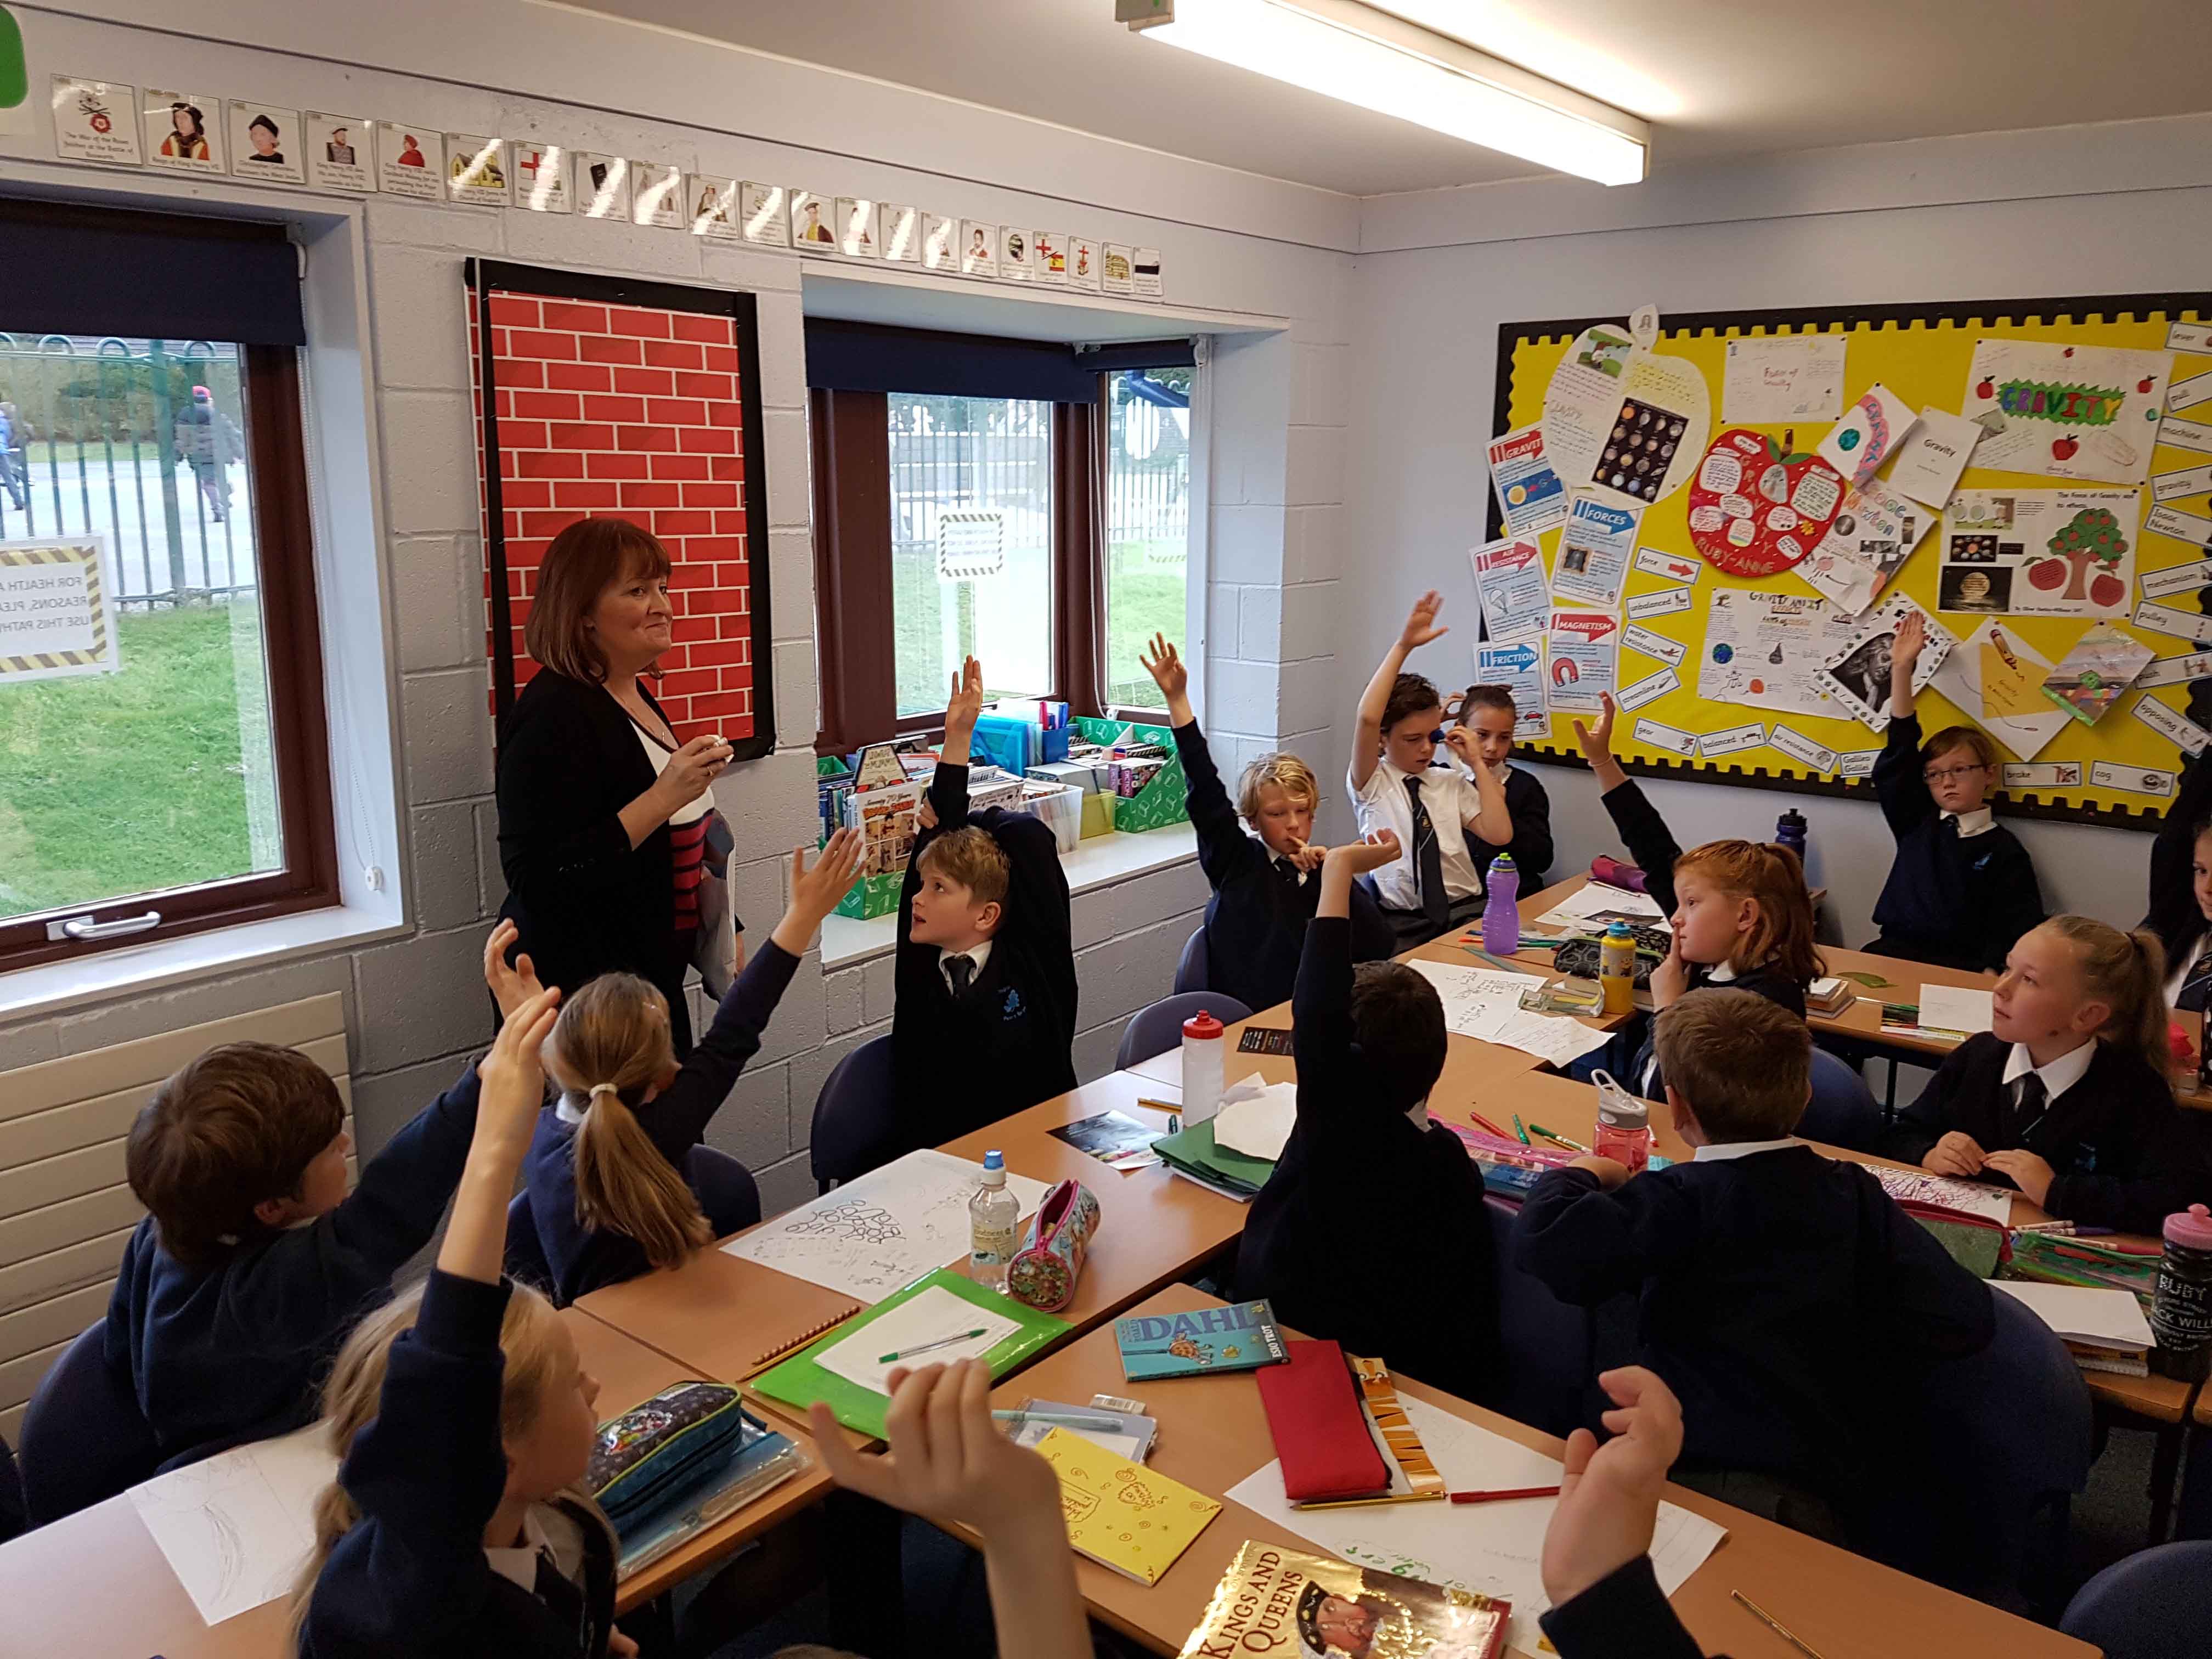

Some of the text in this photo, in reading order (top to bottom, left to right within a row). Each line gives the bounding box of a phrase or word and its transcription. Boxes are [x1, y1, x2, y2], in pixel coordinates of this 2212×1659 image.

[2001, 387, 2125, 420] GRAVITY
[1505, 438, 1542, 458] GRAVIT
[1923, 439, 1957, 457] Gravity
[1587, 510, 1628, 525] FORCES
[1559, 621, 1612, 630] MAGNETISM
[2137, 612, 2168, 626] pulley
[1493, 653, 1537, 665] FRICTION
[2141, 704, 2177, 732] opposing
[1703, 736, 1737, 748] balanced
[1843, 755, 1871, 763] Galileo
[2096, 770, 2112, 782] cog
[2159, 1274, 2207, 1301] RUBY
[1137, 1305, 1263, 1342] DAHL
[2179, 1316, 2212, 1329] WILL
[1261, 1324, 1283, 1359] ESIO TROT
[1197, 1594, 1259, 1659] KINGS
[1248, 1551, 1280, 1593] AND
[1242, 1571, 1304, 1653] QUEENS
